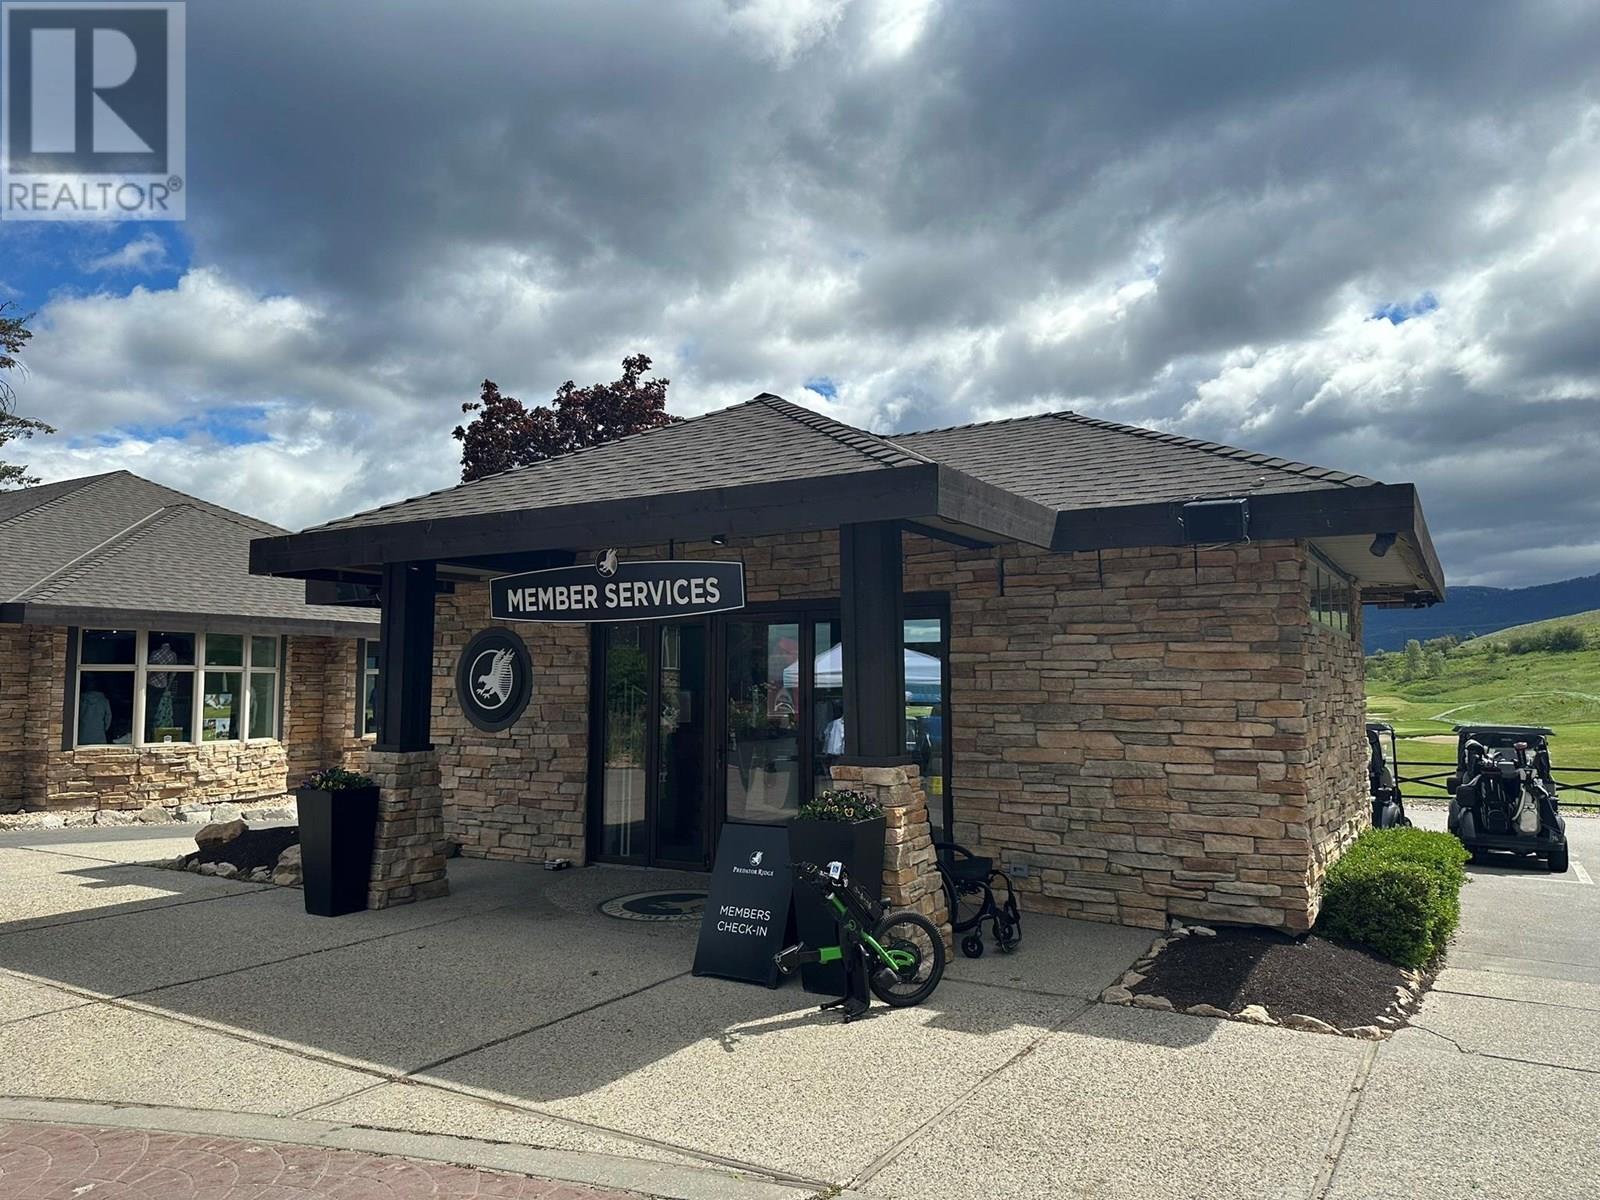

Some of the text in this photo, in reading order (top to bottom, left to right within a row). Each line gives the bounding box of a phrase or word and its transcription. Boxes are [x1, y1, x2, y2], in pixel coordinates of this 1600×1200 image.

[507, 577, 721, 612] MEMBER SERVICES
[719, 905, 771, 921] MEMBERS
[717, 920, 768, 937] CHECK-IN
